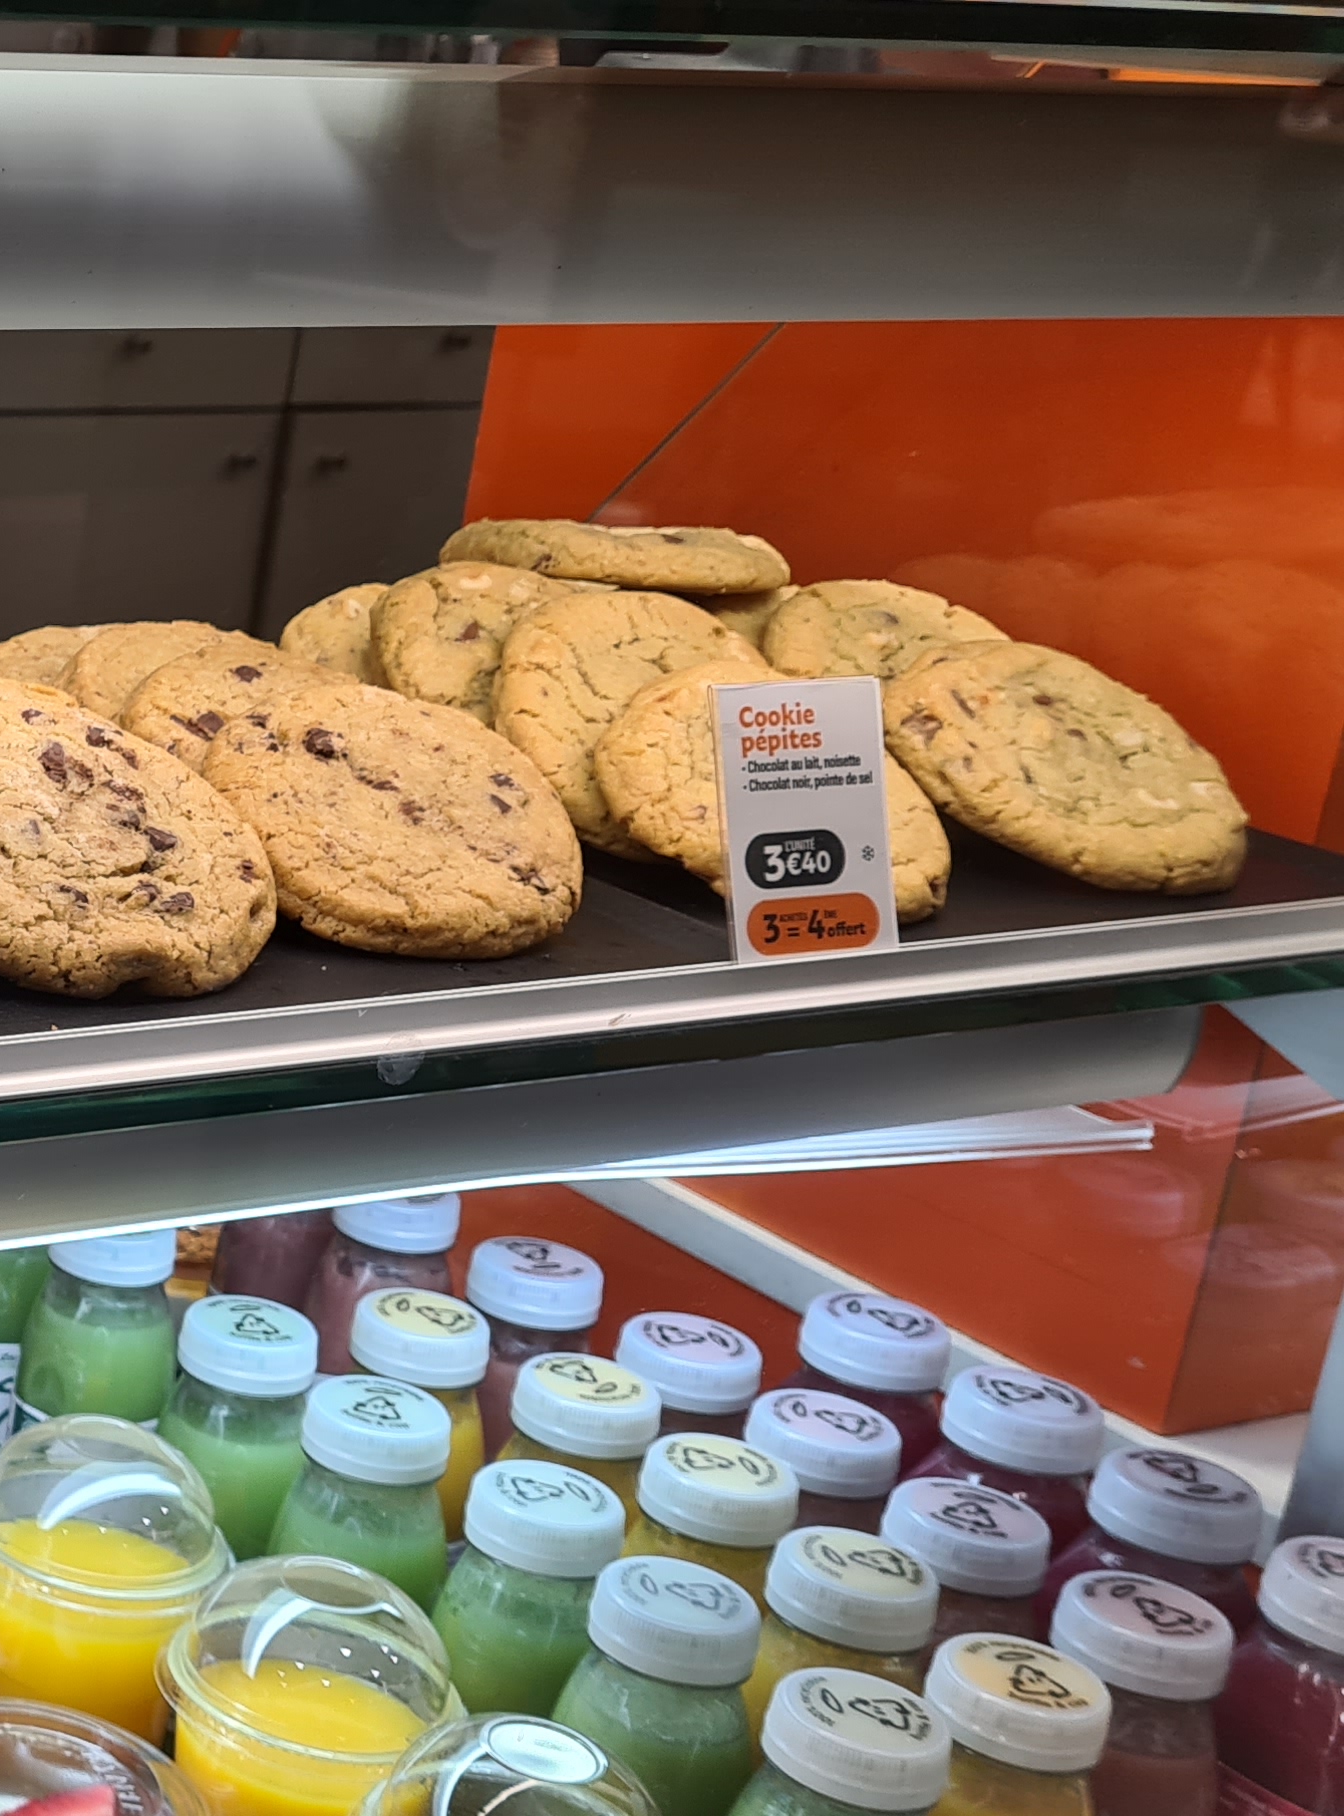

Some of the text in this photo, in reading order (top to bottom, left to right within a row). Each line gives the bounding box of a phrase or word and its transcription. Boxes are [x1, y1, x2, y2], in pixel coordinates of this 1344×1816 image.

[739, 701, 815, 728] Cookie
[740, 727, 822, 758] pépites
[748, 754, 861, 773] Chocolat au lait, noisette
[749, 771, 873, 792] Chocolat noir, pointe de sel
[763, 845, 831, 882] 3€40
[763, 913, 780, 943] 3
[827, 921, 866, 938] offert
